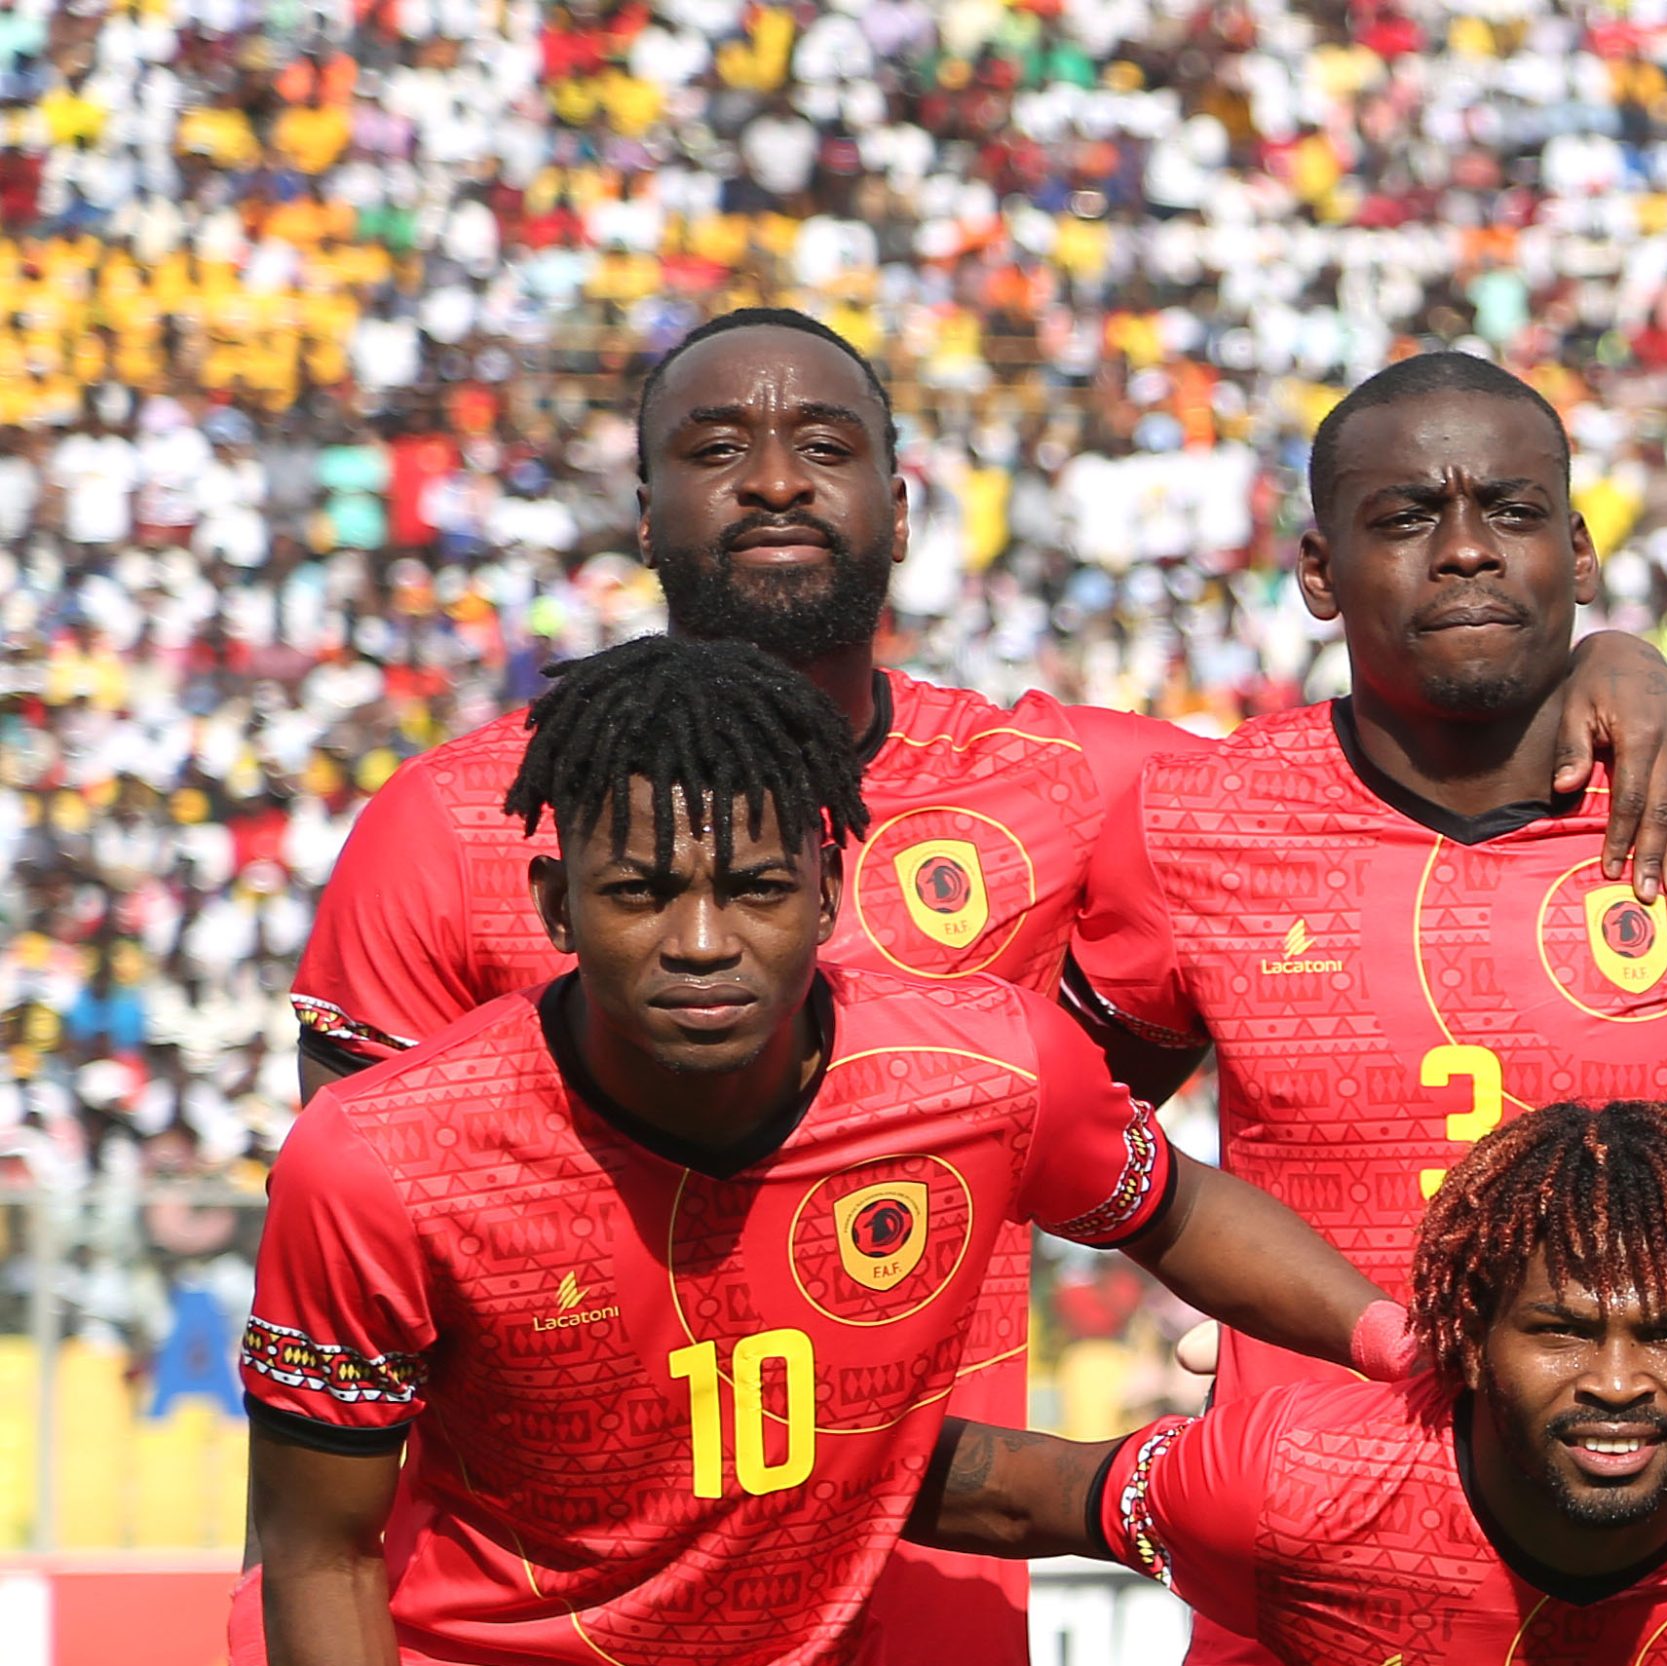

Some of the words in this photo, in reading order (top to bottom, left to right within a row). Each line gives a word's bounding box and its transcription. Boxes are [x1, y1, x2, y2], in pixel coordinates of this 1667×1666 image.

[1261, 958, 1344, 975] Lacatoni
[1419, 1044, 1503, 1200] 3
[533, 1305, 621, 1332] Lacatoni
[668, 1328, 817, 1499] 10
